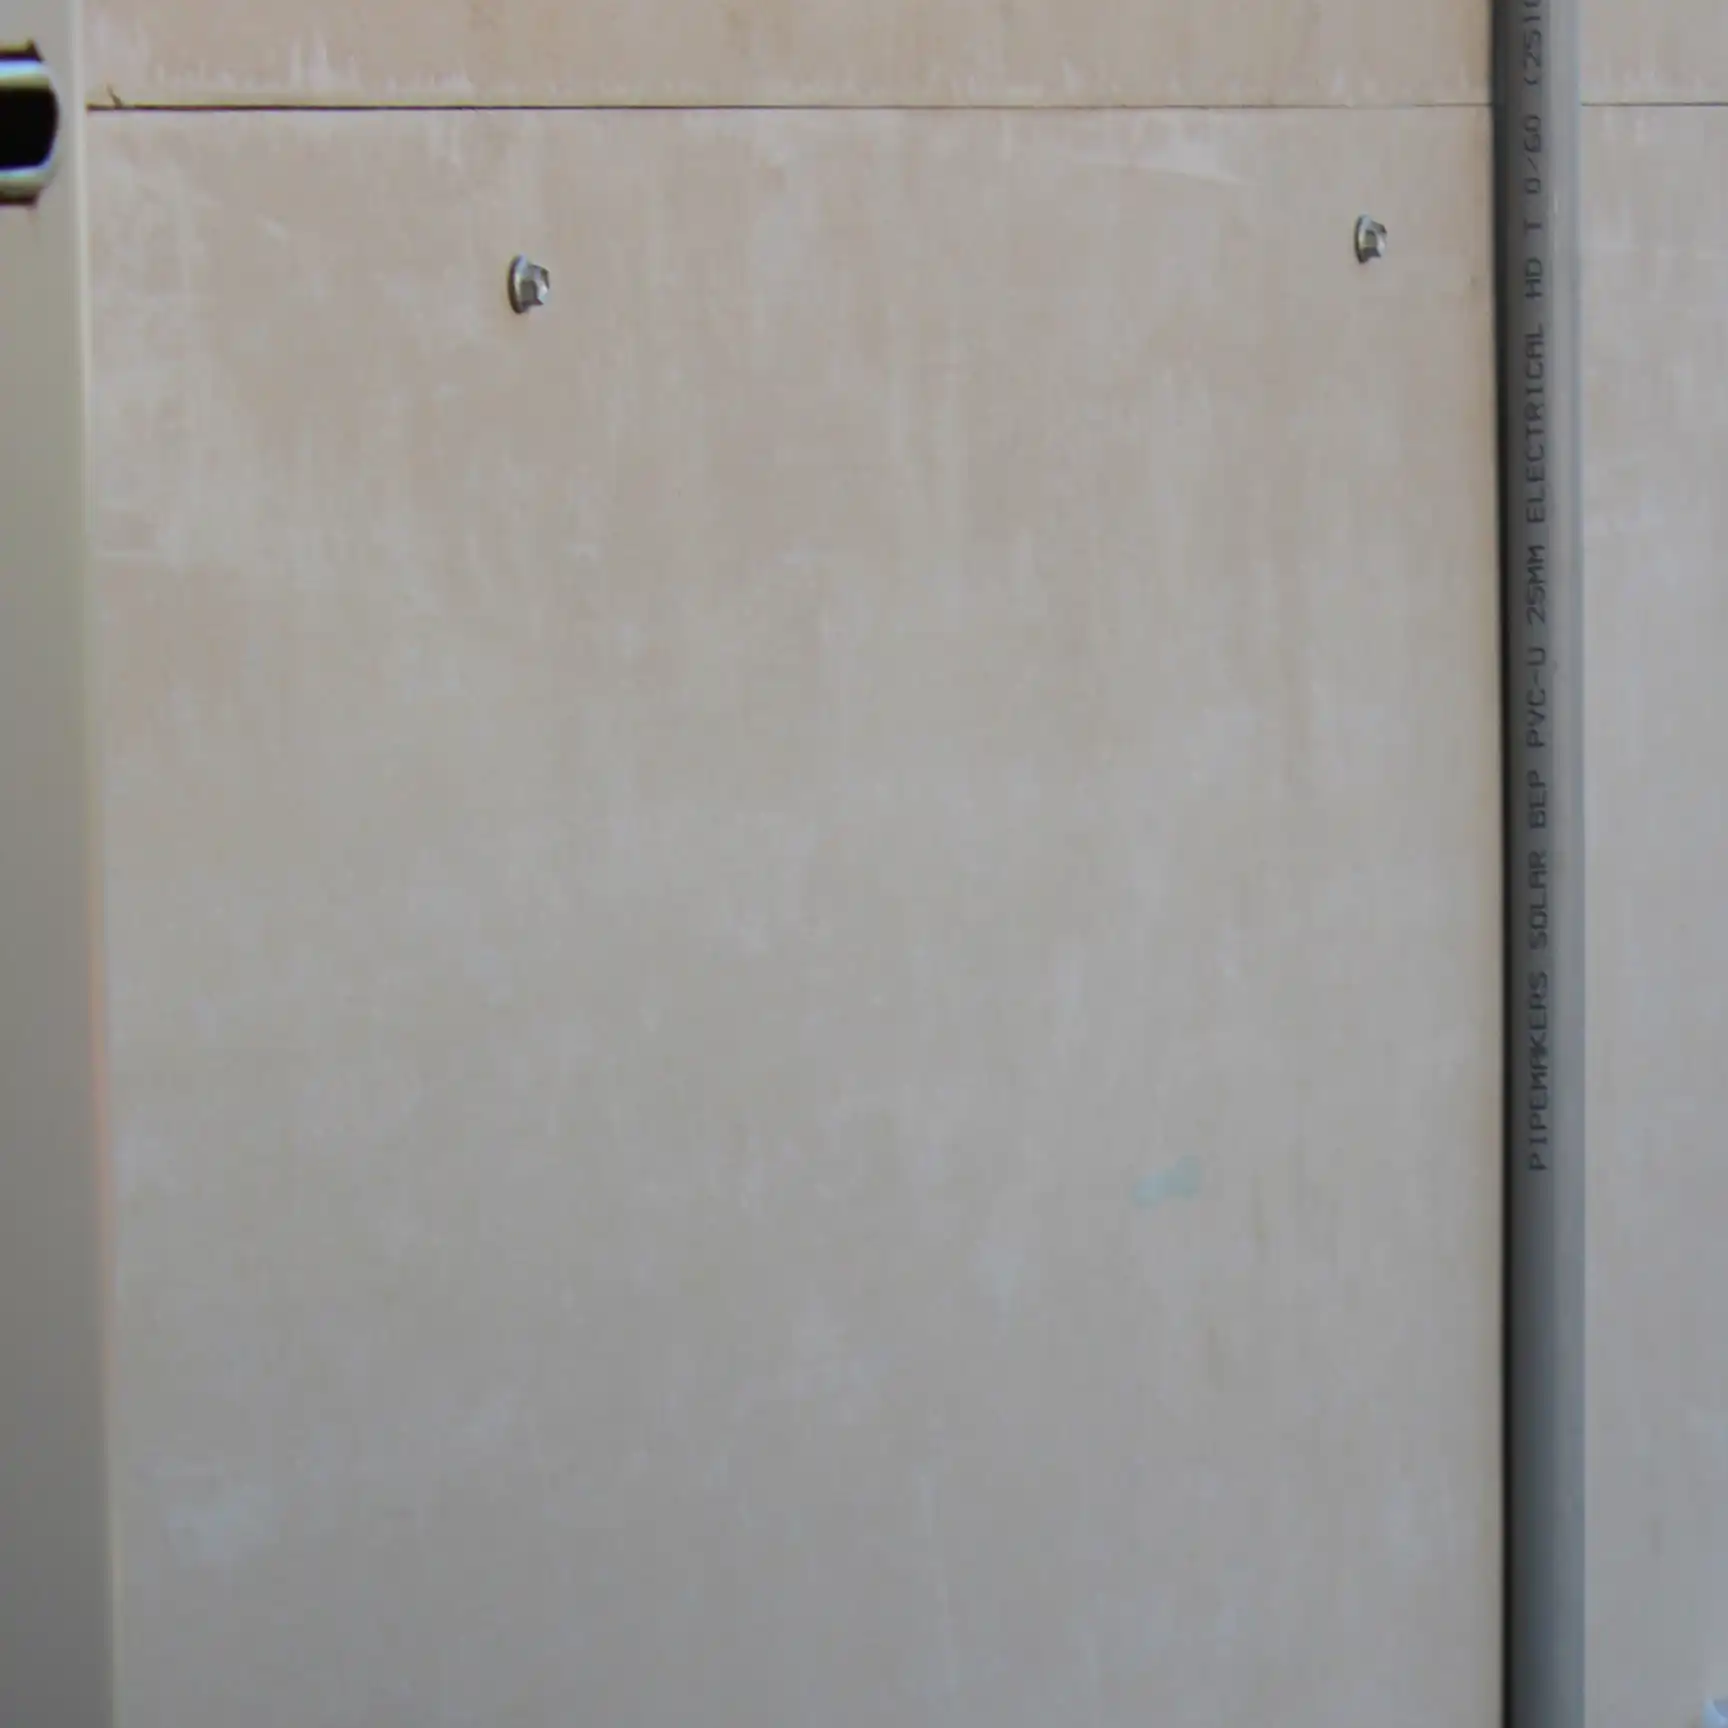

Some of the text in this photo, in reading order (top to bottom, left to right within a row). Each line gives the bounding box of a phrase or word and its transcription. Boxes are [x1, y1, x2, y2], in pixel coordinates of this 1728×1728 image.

[1523, 257, 1543, 299] HD
[1523, 324, 1546, 524] ELECTRICAL
[1525, 544, 1546, 625] 25MM
[1526, 646, 1546, 748] PVC-U
[1527, 850, 1548, 951] SOLAR
[1527, 971, 1549, 1171] PIPEMAKERS
